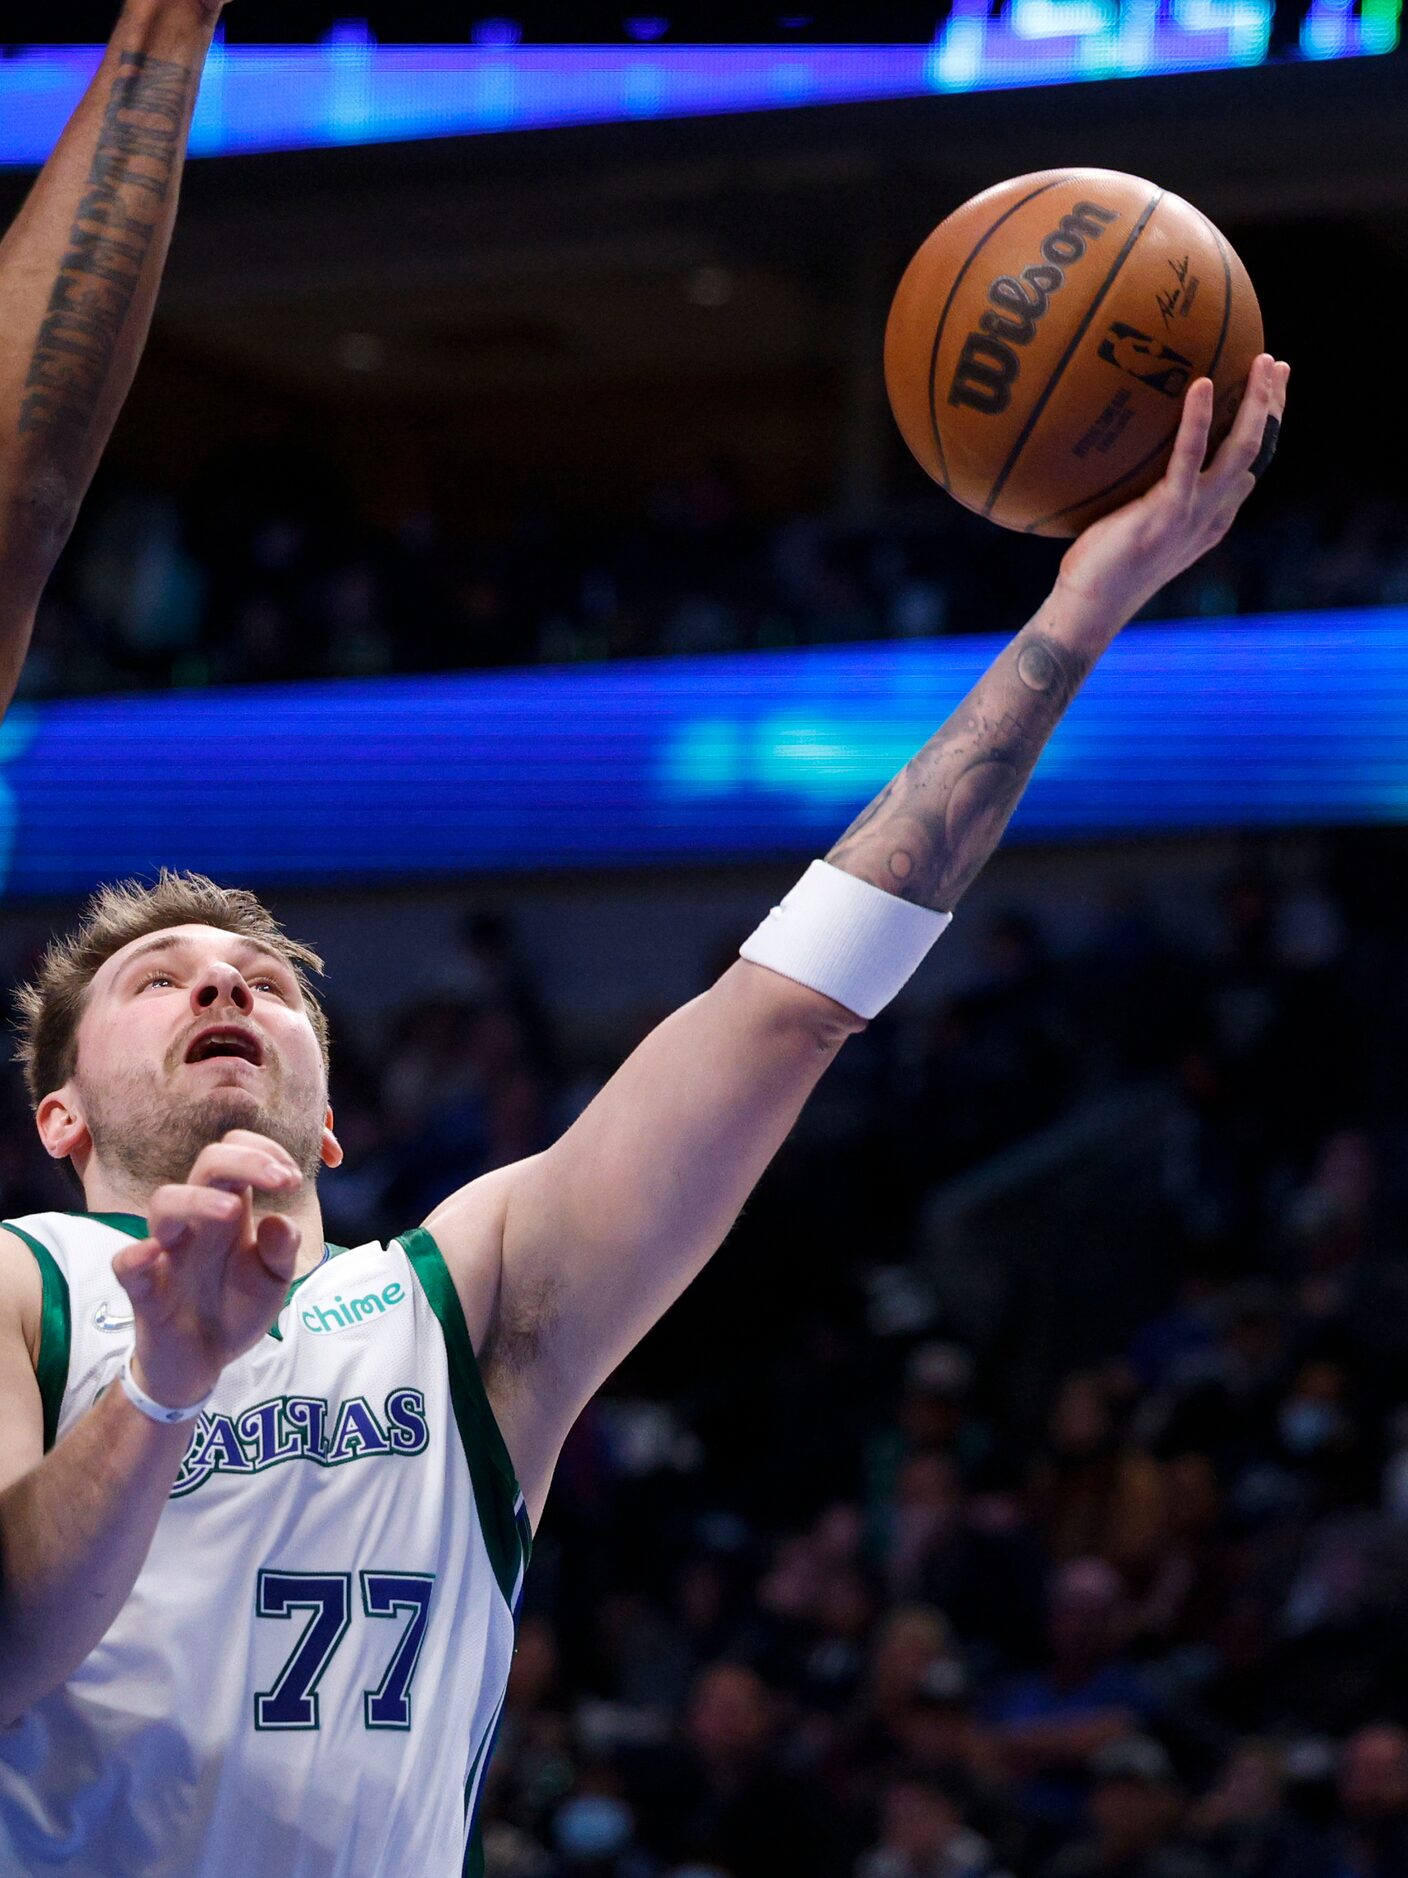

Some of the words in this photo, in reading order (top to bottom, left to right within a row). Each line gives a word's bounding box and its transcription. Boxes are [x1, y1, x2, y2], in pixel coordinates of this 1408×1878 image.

[948, 202, 1119, 415] Wilson
[302, 1282, 404, 1334] chime
[254, 1568, 437, 1732] 77
